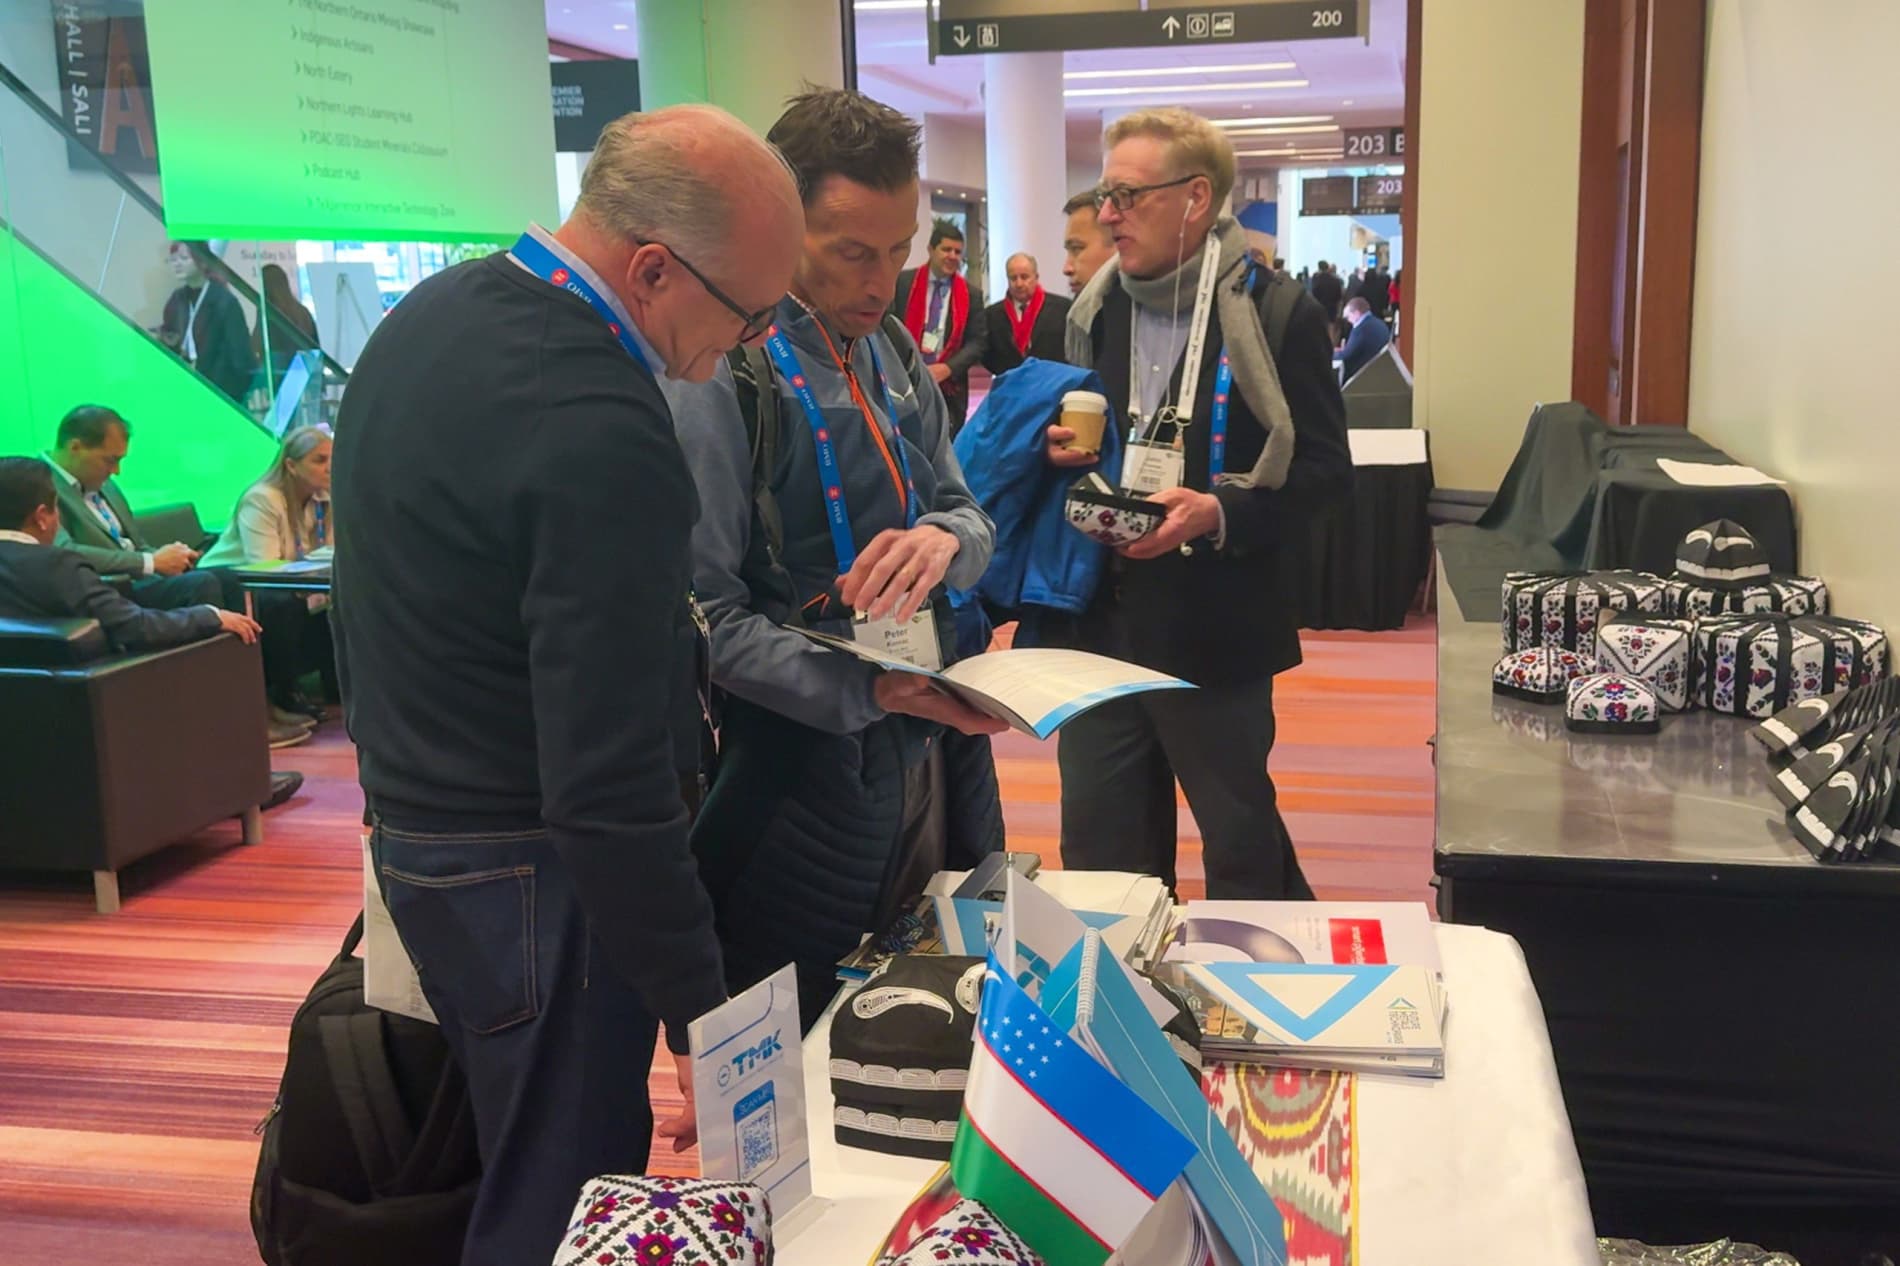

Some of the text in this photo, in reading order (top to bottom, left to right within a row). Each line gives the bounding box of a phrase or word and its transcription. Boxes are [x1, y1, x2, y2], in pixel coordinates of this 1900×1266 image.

[1312, 10, 1342, 27] 200
[64, 4, 84, 62] HALL
[300, 28, 341, 48] Indigenous
[303, 62, 326, 78] North
[98, 17, 157, 158] A
[306, 96, 340, 114] Northern
[1348, 135, 1385, 155] 203
[1377, 180, 1403, 195] 203
[884, 628, 908, 639] Peter
[732, 1028, 783, 1075] TMK
